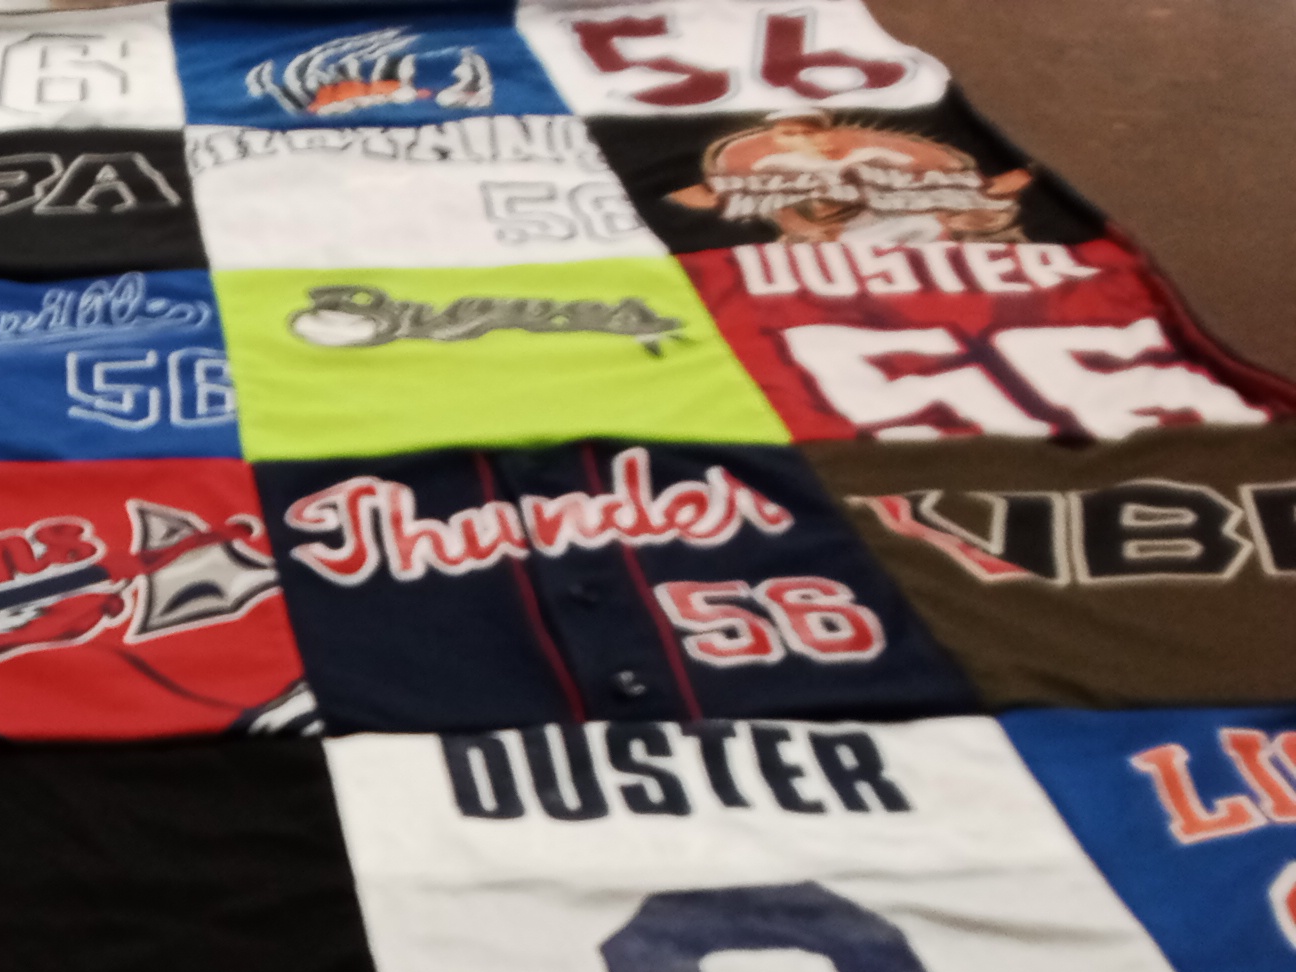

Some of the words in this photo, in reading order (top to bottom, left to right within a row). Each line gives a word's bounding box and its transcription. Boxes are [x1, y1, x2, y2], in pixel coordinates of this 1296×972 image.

[567, 10, 916, 107] 56
[478, 179, 644, 244] 56
[65, 347, 235, 430] 56
[285, 446, 795, 585] Thunder
[654, 575, 886, 668] 56
[437, 721, 917, 823] DUSTER
